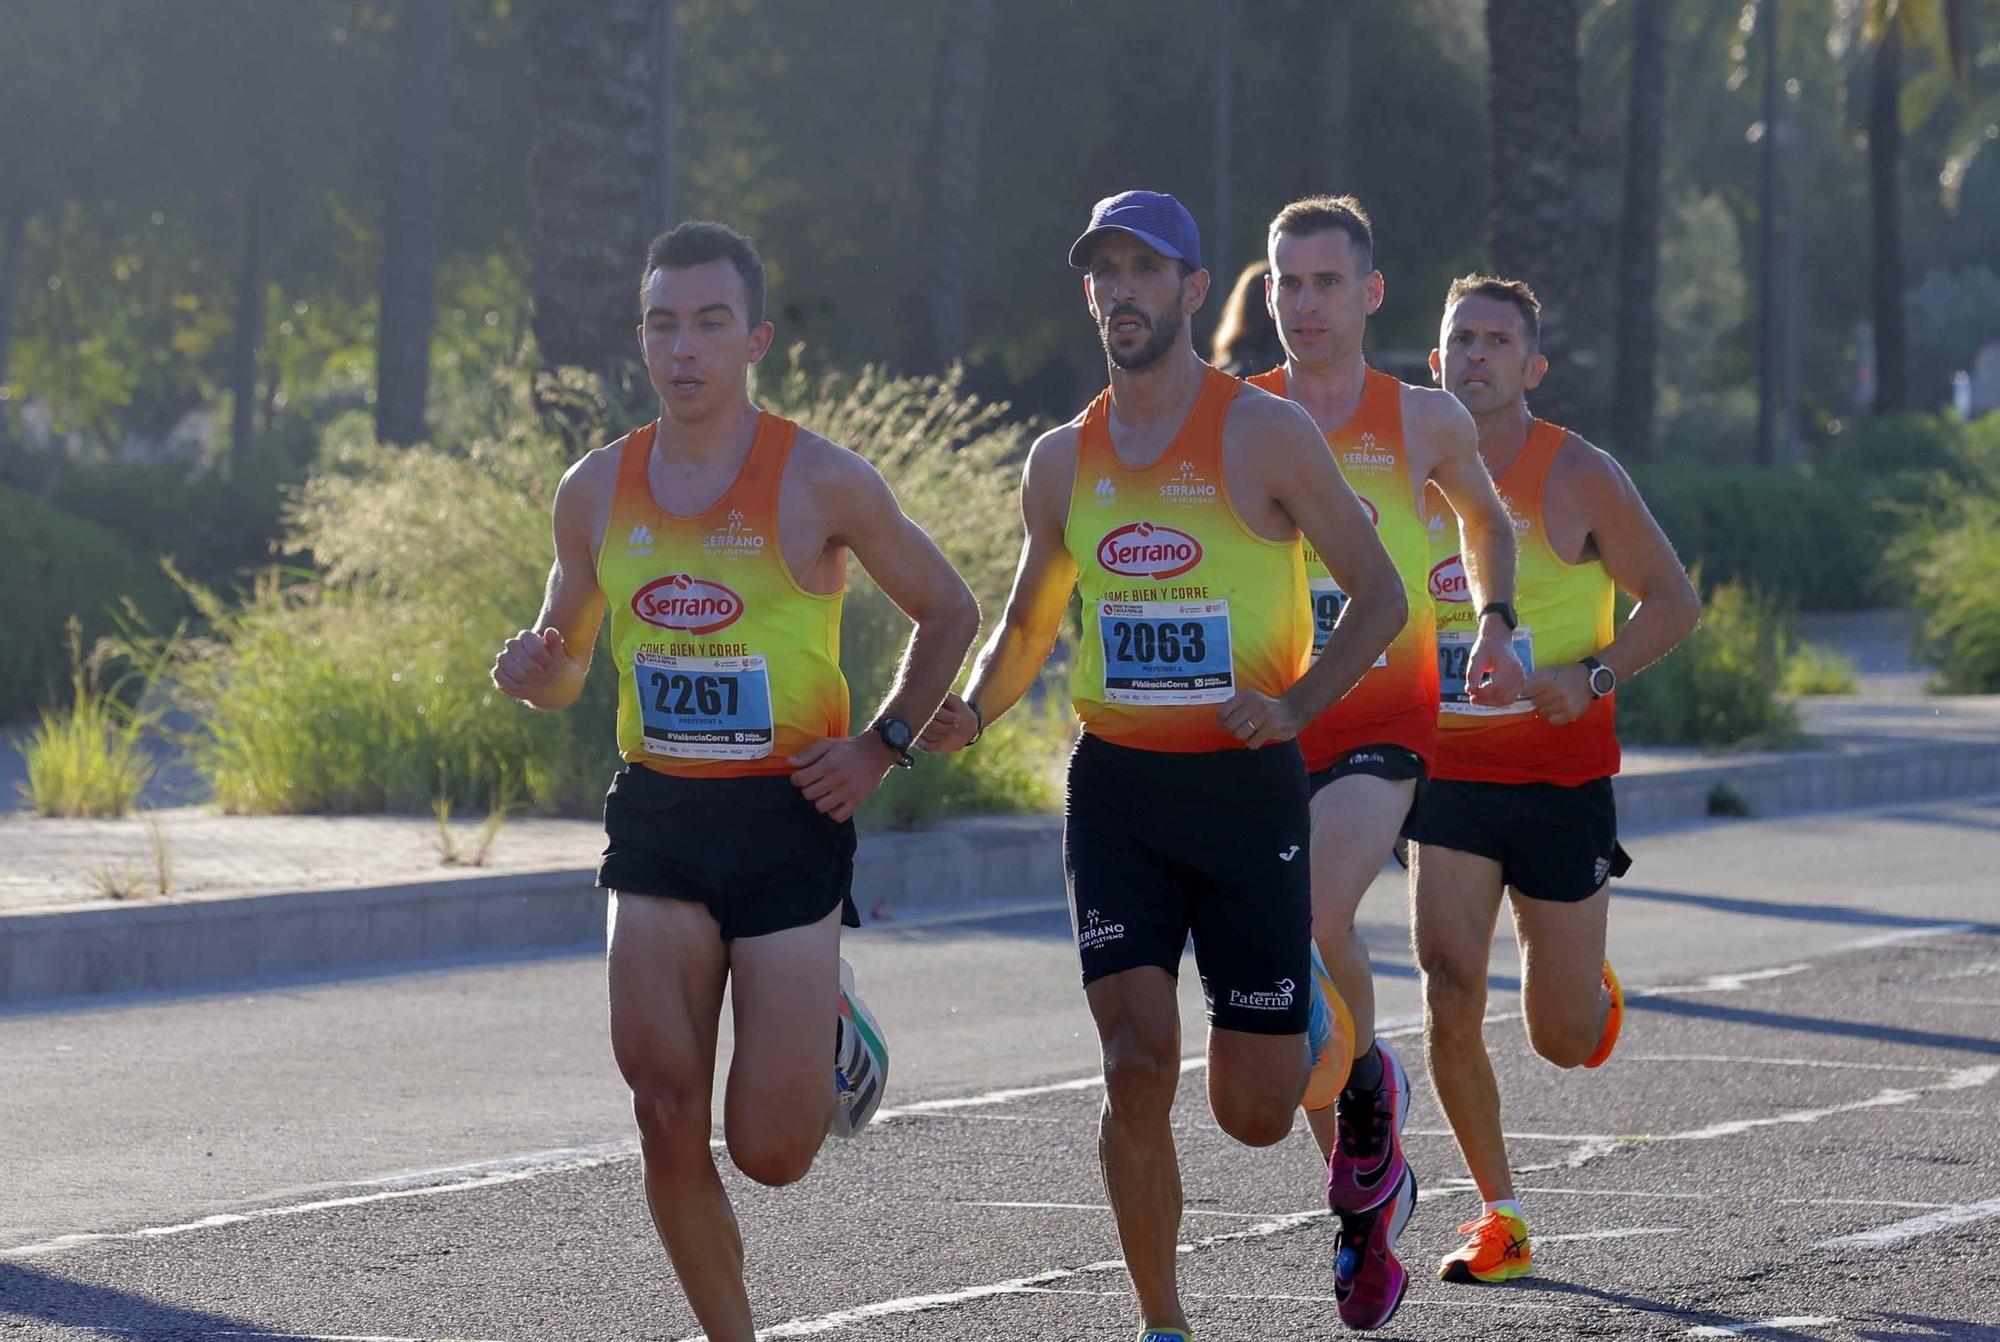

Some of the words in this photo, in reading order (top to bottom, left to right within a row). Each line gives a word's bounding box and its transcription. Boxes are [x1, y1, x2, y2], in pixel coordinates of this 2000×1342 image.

[1343, 453, 1395, 464] SERRANO
[1160, 485, 1216, 496] SERRANO
[703, 536, 764, 547] SERRANO
[1106, 541, 1192, 566] Serrano
[1433, 572, 1467, 595] Serr
[1132, 589, 1157, 602] BIEN
[1161, 588, 1168, 600] Y
[1171, 587, 1209, 600] CORRE
[643, 594, 733, 617] Serrano
[670, 643, 695, 656] BIEN
[699, 643, 706, 656] Y
[709, 643, 749, 656] CORRE
[1113, 621, 1206, 664] 2063
[1440, 646, 1469, 679] 22
[651, 671, 739, 716] 2267
[667, 732, 730, 742] #ValènciaCorre
[1230, 989, 1289, 1007] Paterna
